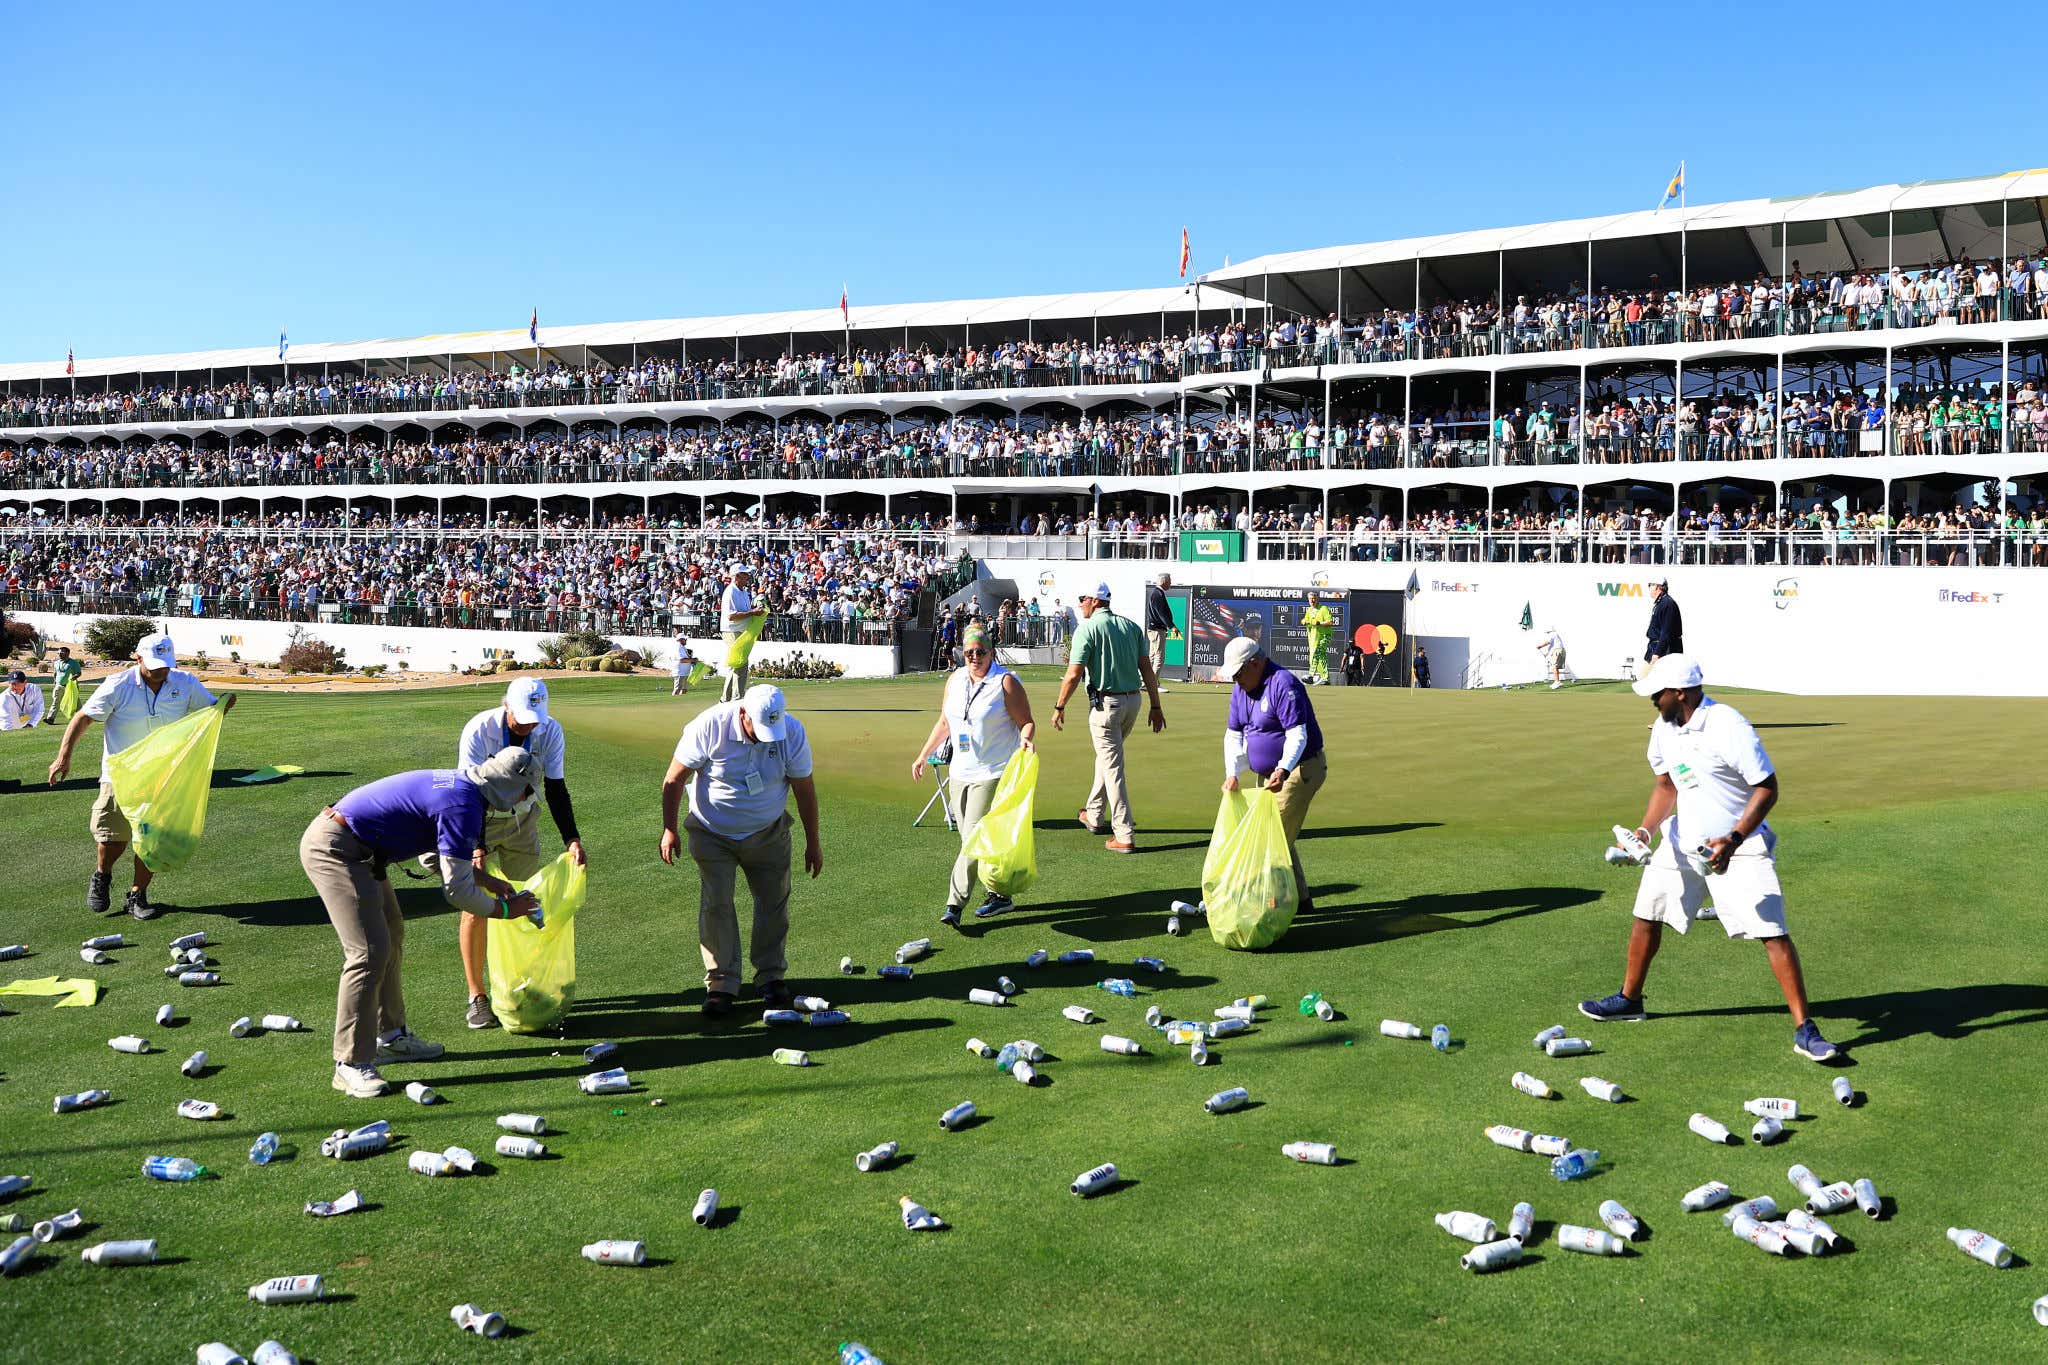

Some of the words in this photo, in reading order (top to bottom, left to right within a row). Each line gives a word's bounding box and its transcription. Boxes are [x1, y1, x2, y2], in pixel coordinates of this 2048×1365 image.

[1441, 582, 1469, 592] FedEx
[1596, 582, 1643, 597] WM
[1232, 588, 1248, 597] WM
[1249, 588, 1281, 598] PHOENIX
[1283, 589, 1303, 599] OPEN
[1951, 591, 1989, 603] FedEx
[220, 634, 244, 646] WM
[1194, 643, 1210, 652] SAM
[1194, 653, 1219, 663] RYDER
